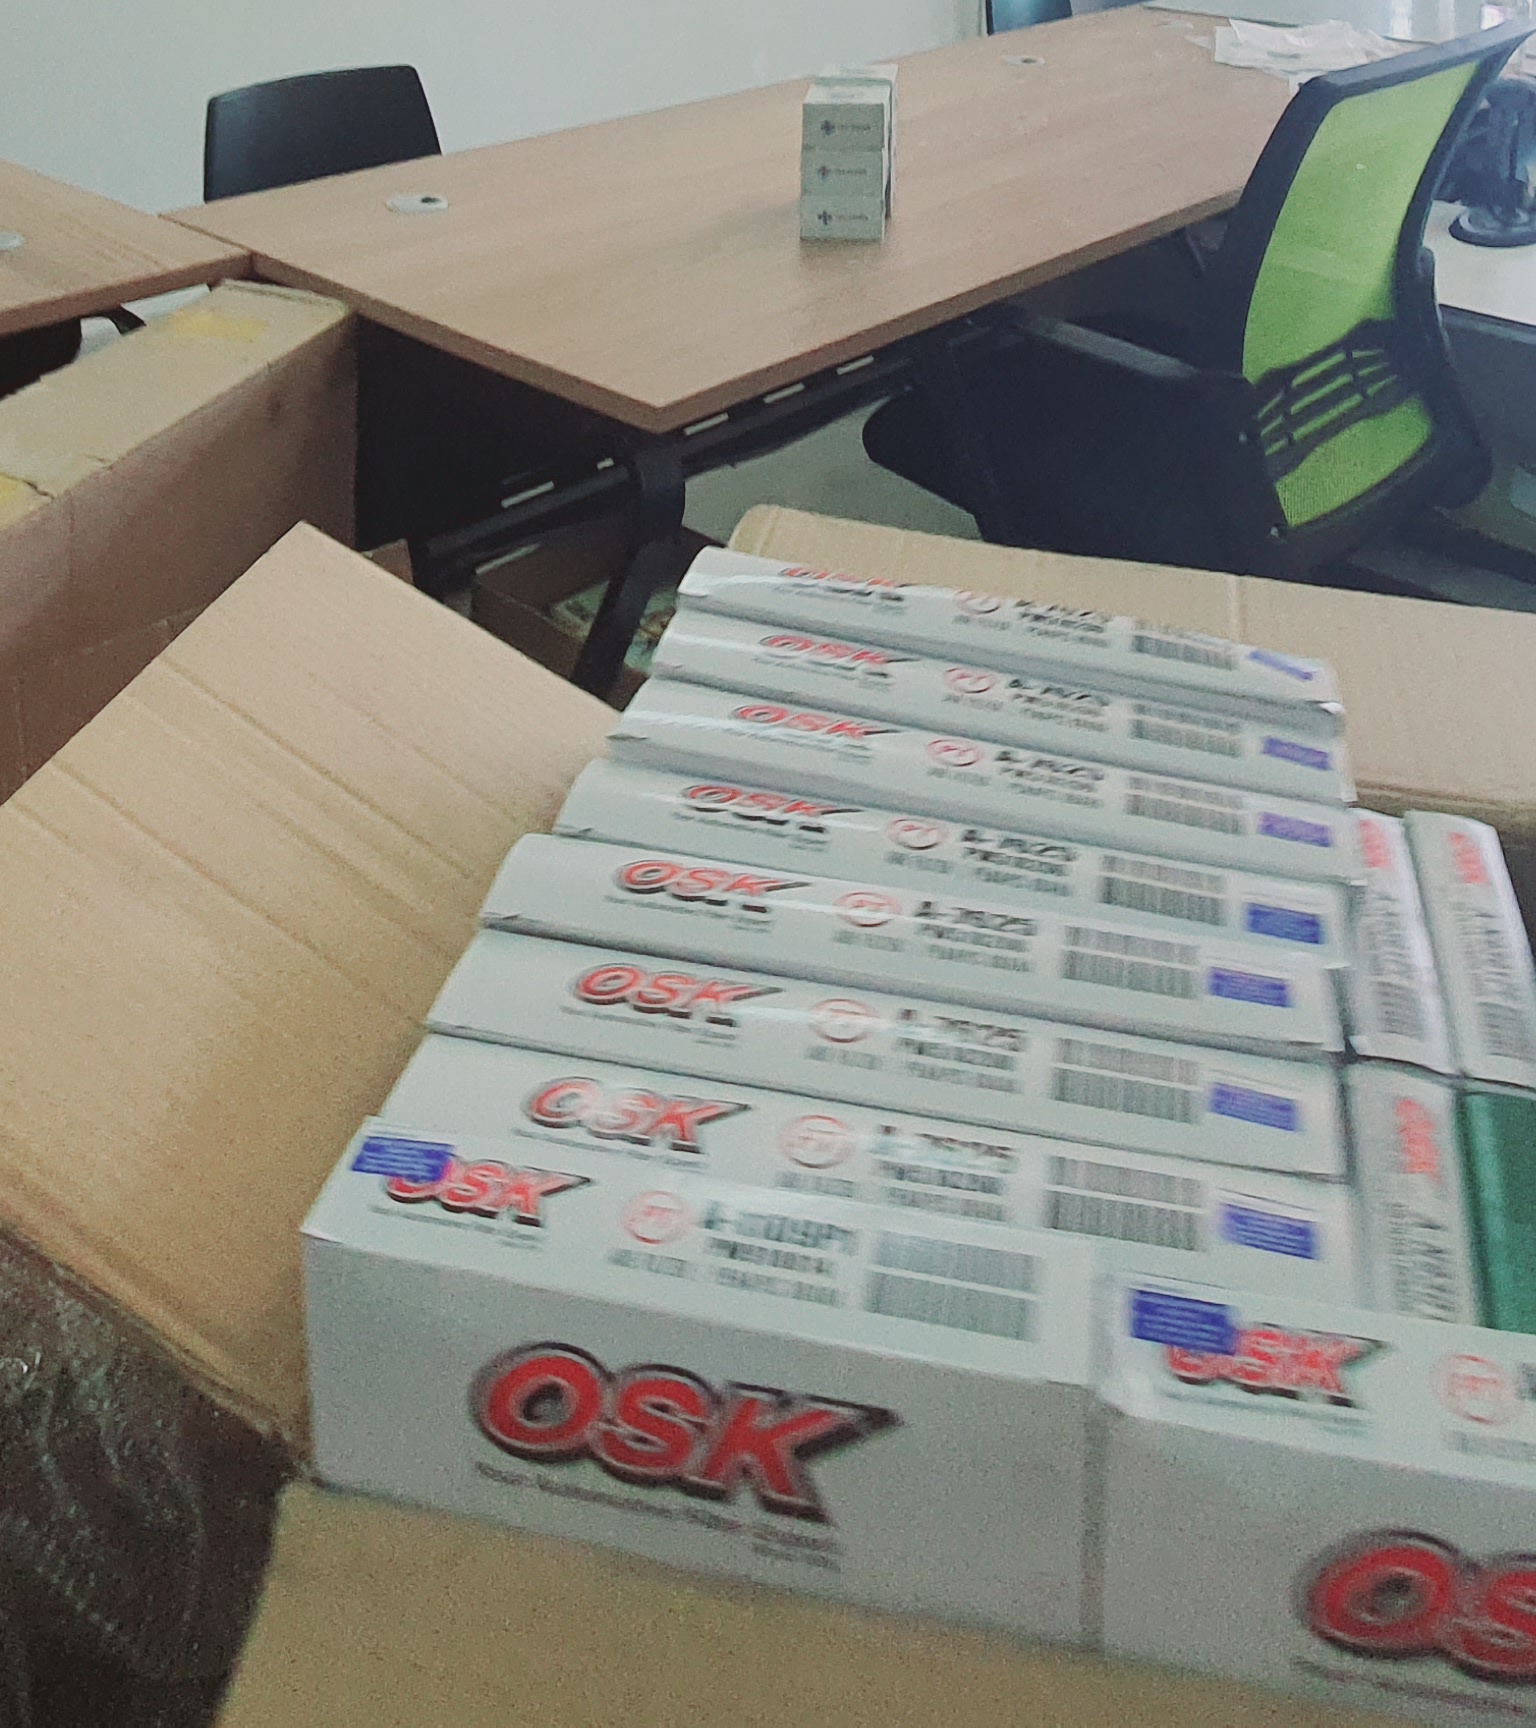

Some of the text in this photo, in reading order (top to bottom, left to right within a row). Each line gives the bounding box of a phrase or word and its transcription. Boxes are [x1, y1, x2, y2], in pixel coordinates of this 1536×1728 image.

[761, 633, 920, 675] OSK
[730, 702, 905, 746] OSK
[681, 783, 863, 833] OSK
[617, 860, 810, 913] OSK
[573, 962, 784, 1027] OSK
[522, 1076, 751, 1154] OSK
[470, 1341, 902, 1524] OSK
